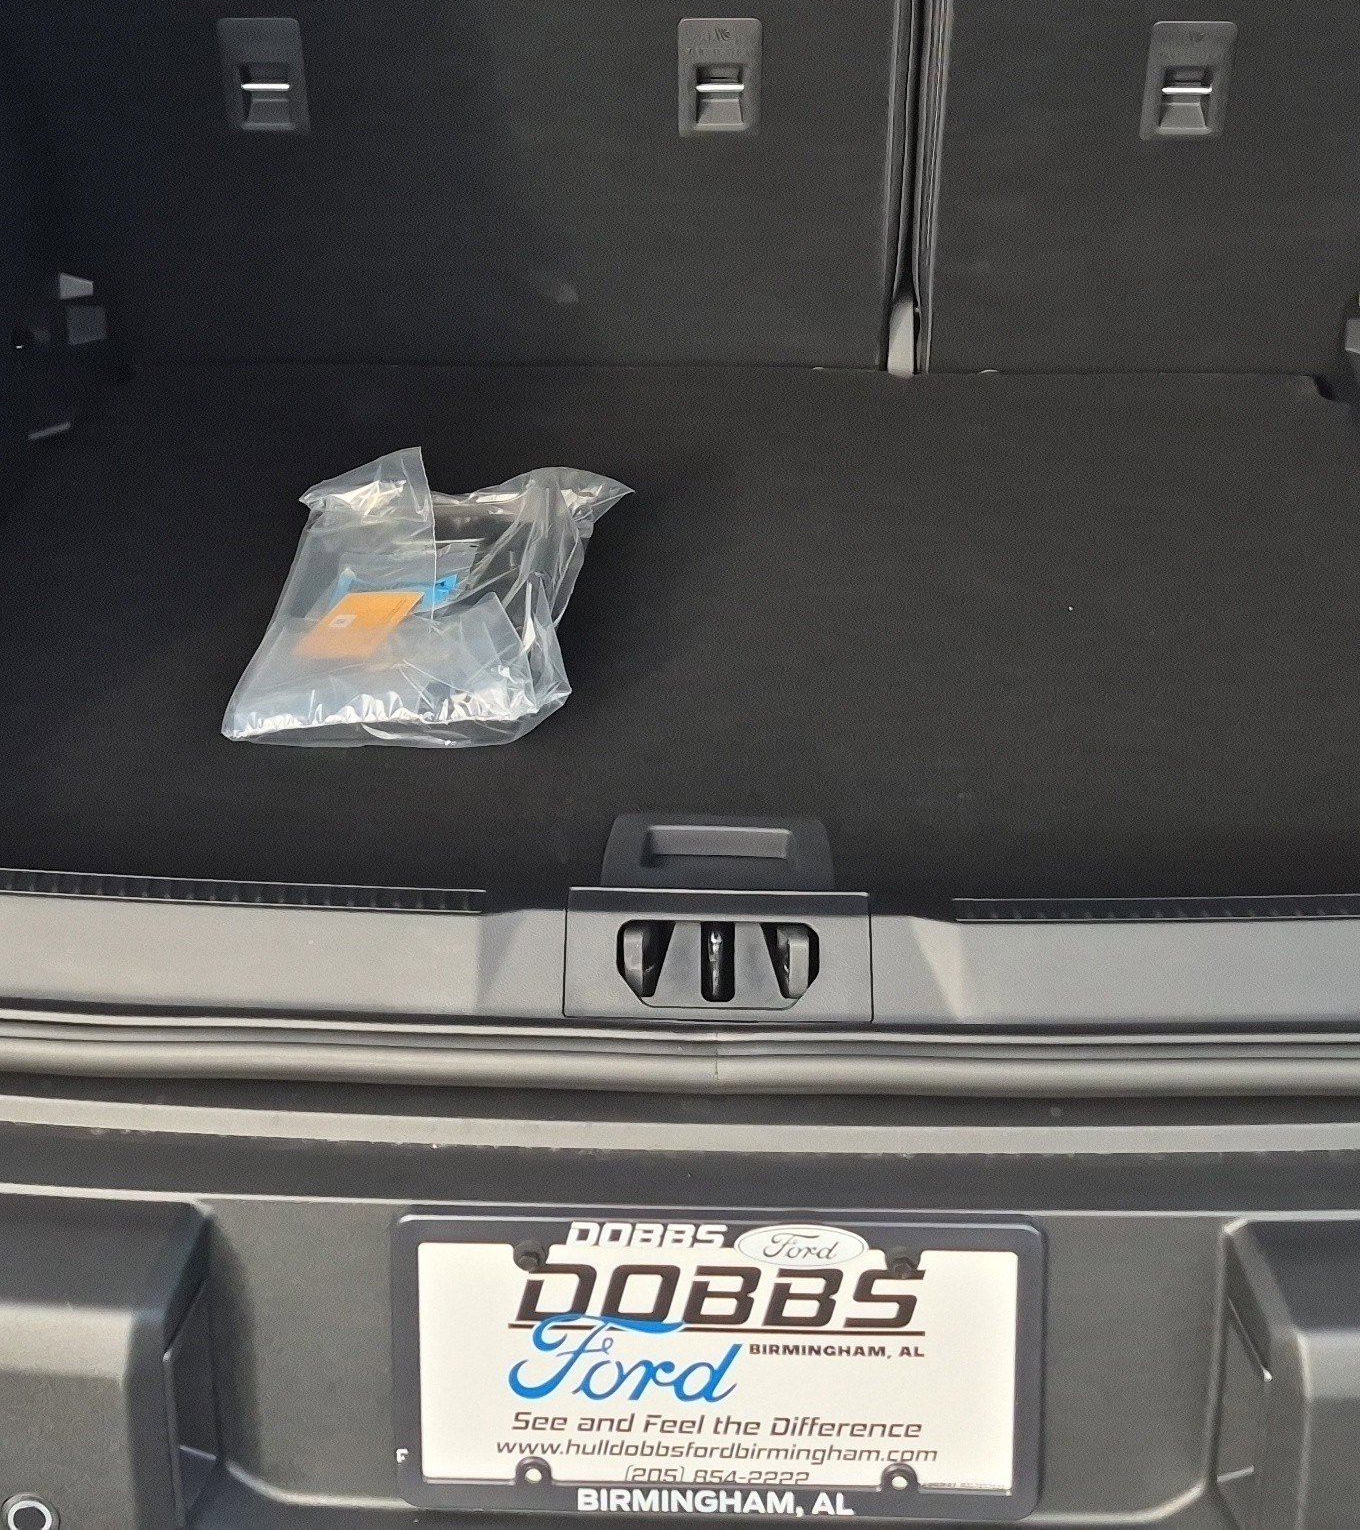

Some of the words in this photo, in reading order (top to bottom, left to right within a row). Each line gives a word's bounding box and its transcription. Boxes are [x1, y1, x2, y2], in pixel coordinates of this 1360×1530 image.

[566, 1220, 728, 1249] DOBBS
[763, 1231, 839, 1260] Ford
[514, 1262, 926, 1330] DOBBS
[508, 1312, 743, 1403] Ford
[748, 1343, 892, 1359] BIRMINGHAM,
[898, 1346, 925, 1358] AL
[512, 1411, 568, 1431] See
[577, 1412, 635, 1433] and
[643, 1414, 705, 1435] Feel
[712, 1415, 761, 1436] the
[770, 1416, 923, 1438] Difference
[496, 1438, 938, 1466] www.hulldobbsfordbirmingham.com
[624, 1464, 686, 1483] (205)
[693, 1469, 810, 1485] 854-2222
[577, 1487, 804, 1518] BIRMINGHAM,
[811, 1491, 855, 1516] AL
